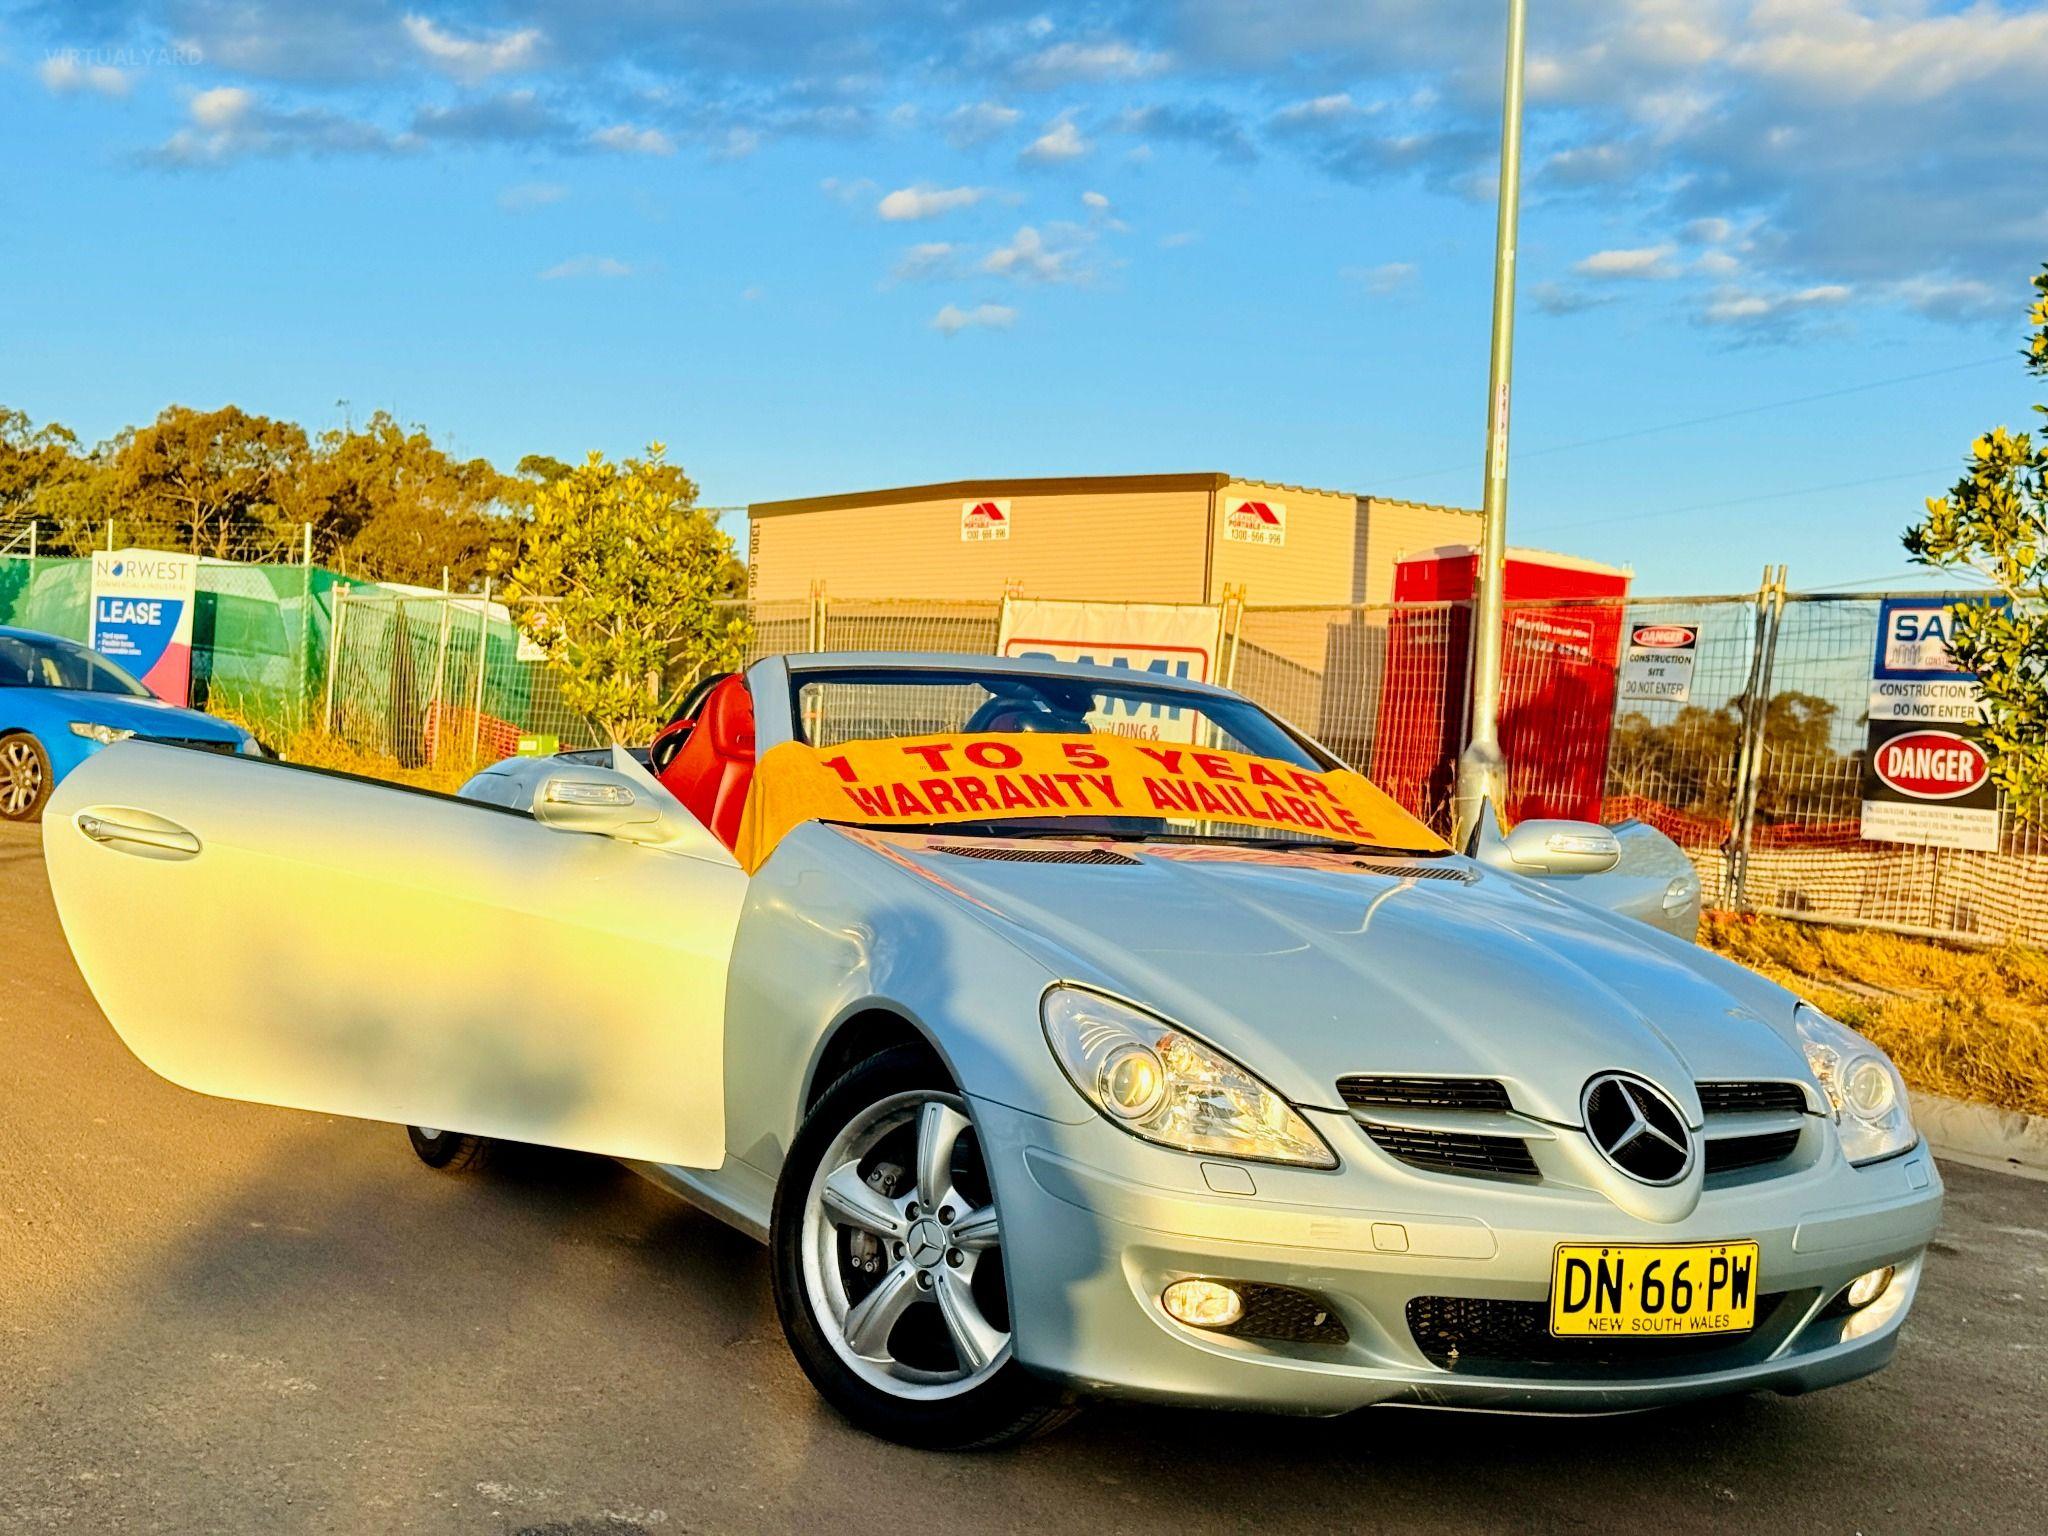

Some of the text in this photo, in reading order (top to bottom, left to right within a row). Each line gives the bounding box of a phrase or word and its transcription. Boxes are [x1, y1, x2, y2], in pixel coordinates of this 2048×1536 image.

[97, 560, 188, 580] NORWEST
[99, 600, 162, 625] LEASE
[1641, 630, 1685, 643] DANGER
[1629, 653, 1692, 665] CONSTRUCTION
[1647, 668, 1665, 677] SITE
[1625, 680, 1685, 696] DO NOT ENTER
[1879, 683, 1967, 698] CONSTRUCTION
[1893, 703, 1975, 718] DO NOT ENTER
[1887, 746, 1975, 782] DANGER
[820, 741, 1341, 805] 1 TO 5 YEAR
[842, 774, 1377, 839] WARRANTY AVAILABLE
[1588, 1314, 1730, 1332] NEW SOUTH WALES
